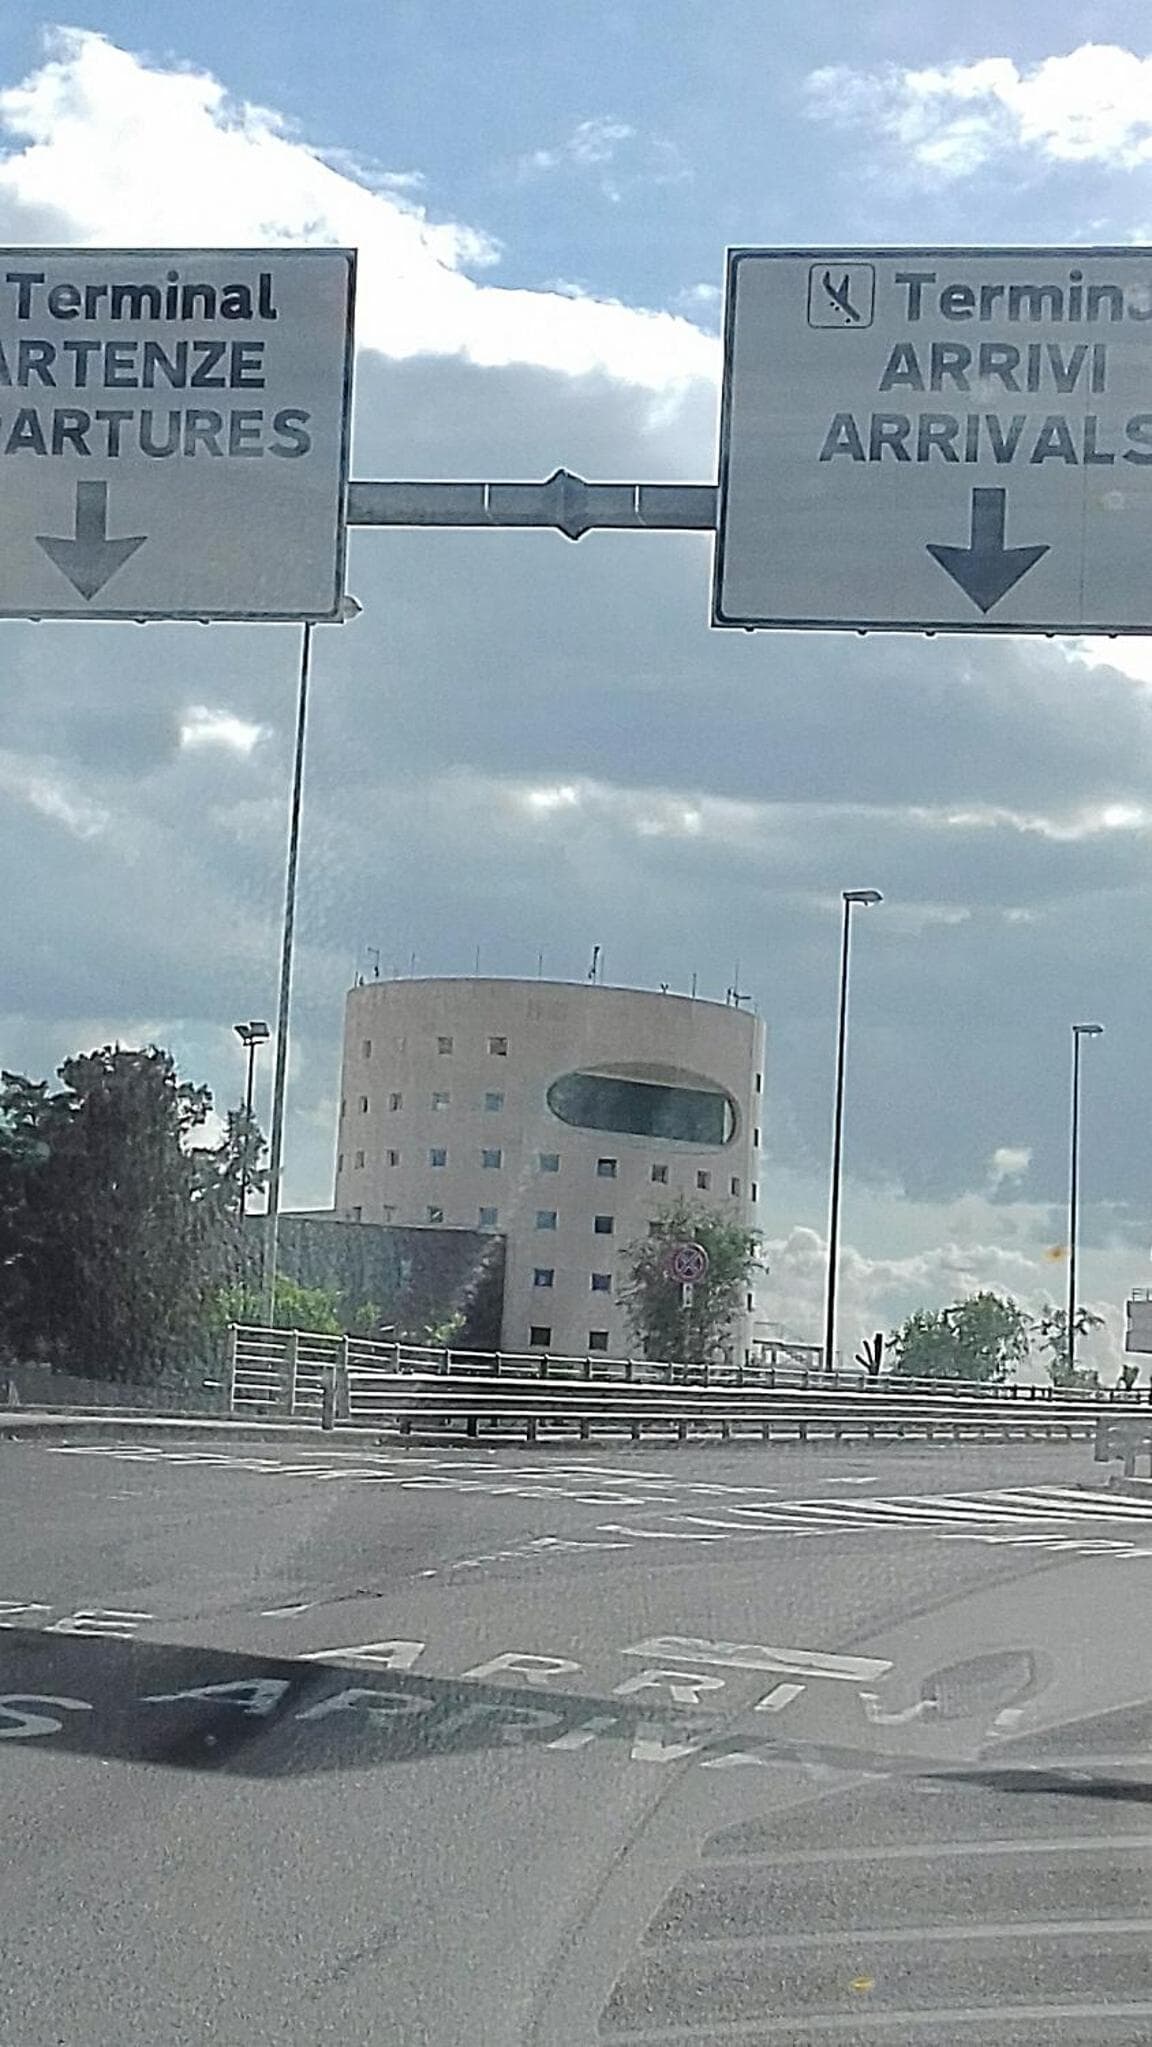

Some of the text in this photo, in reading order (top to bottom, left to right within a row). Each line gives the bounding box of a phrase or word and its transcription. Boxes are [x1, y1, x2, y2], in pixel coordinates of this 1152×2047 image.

[6, 270, 278, 320] Terminal
[0, 340, 265, 389] RTENZE
[878, 343, 1106, 393] ARRIVI
[819, 412, 1152, 465] ARRIVALS
